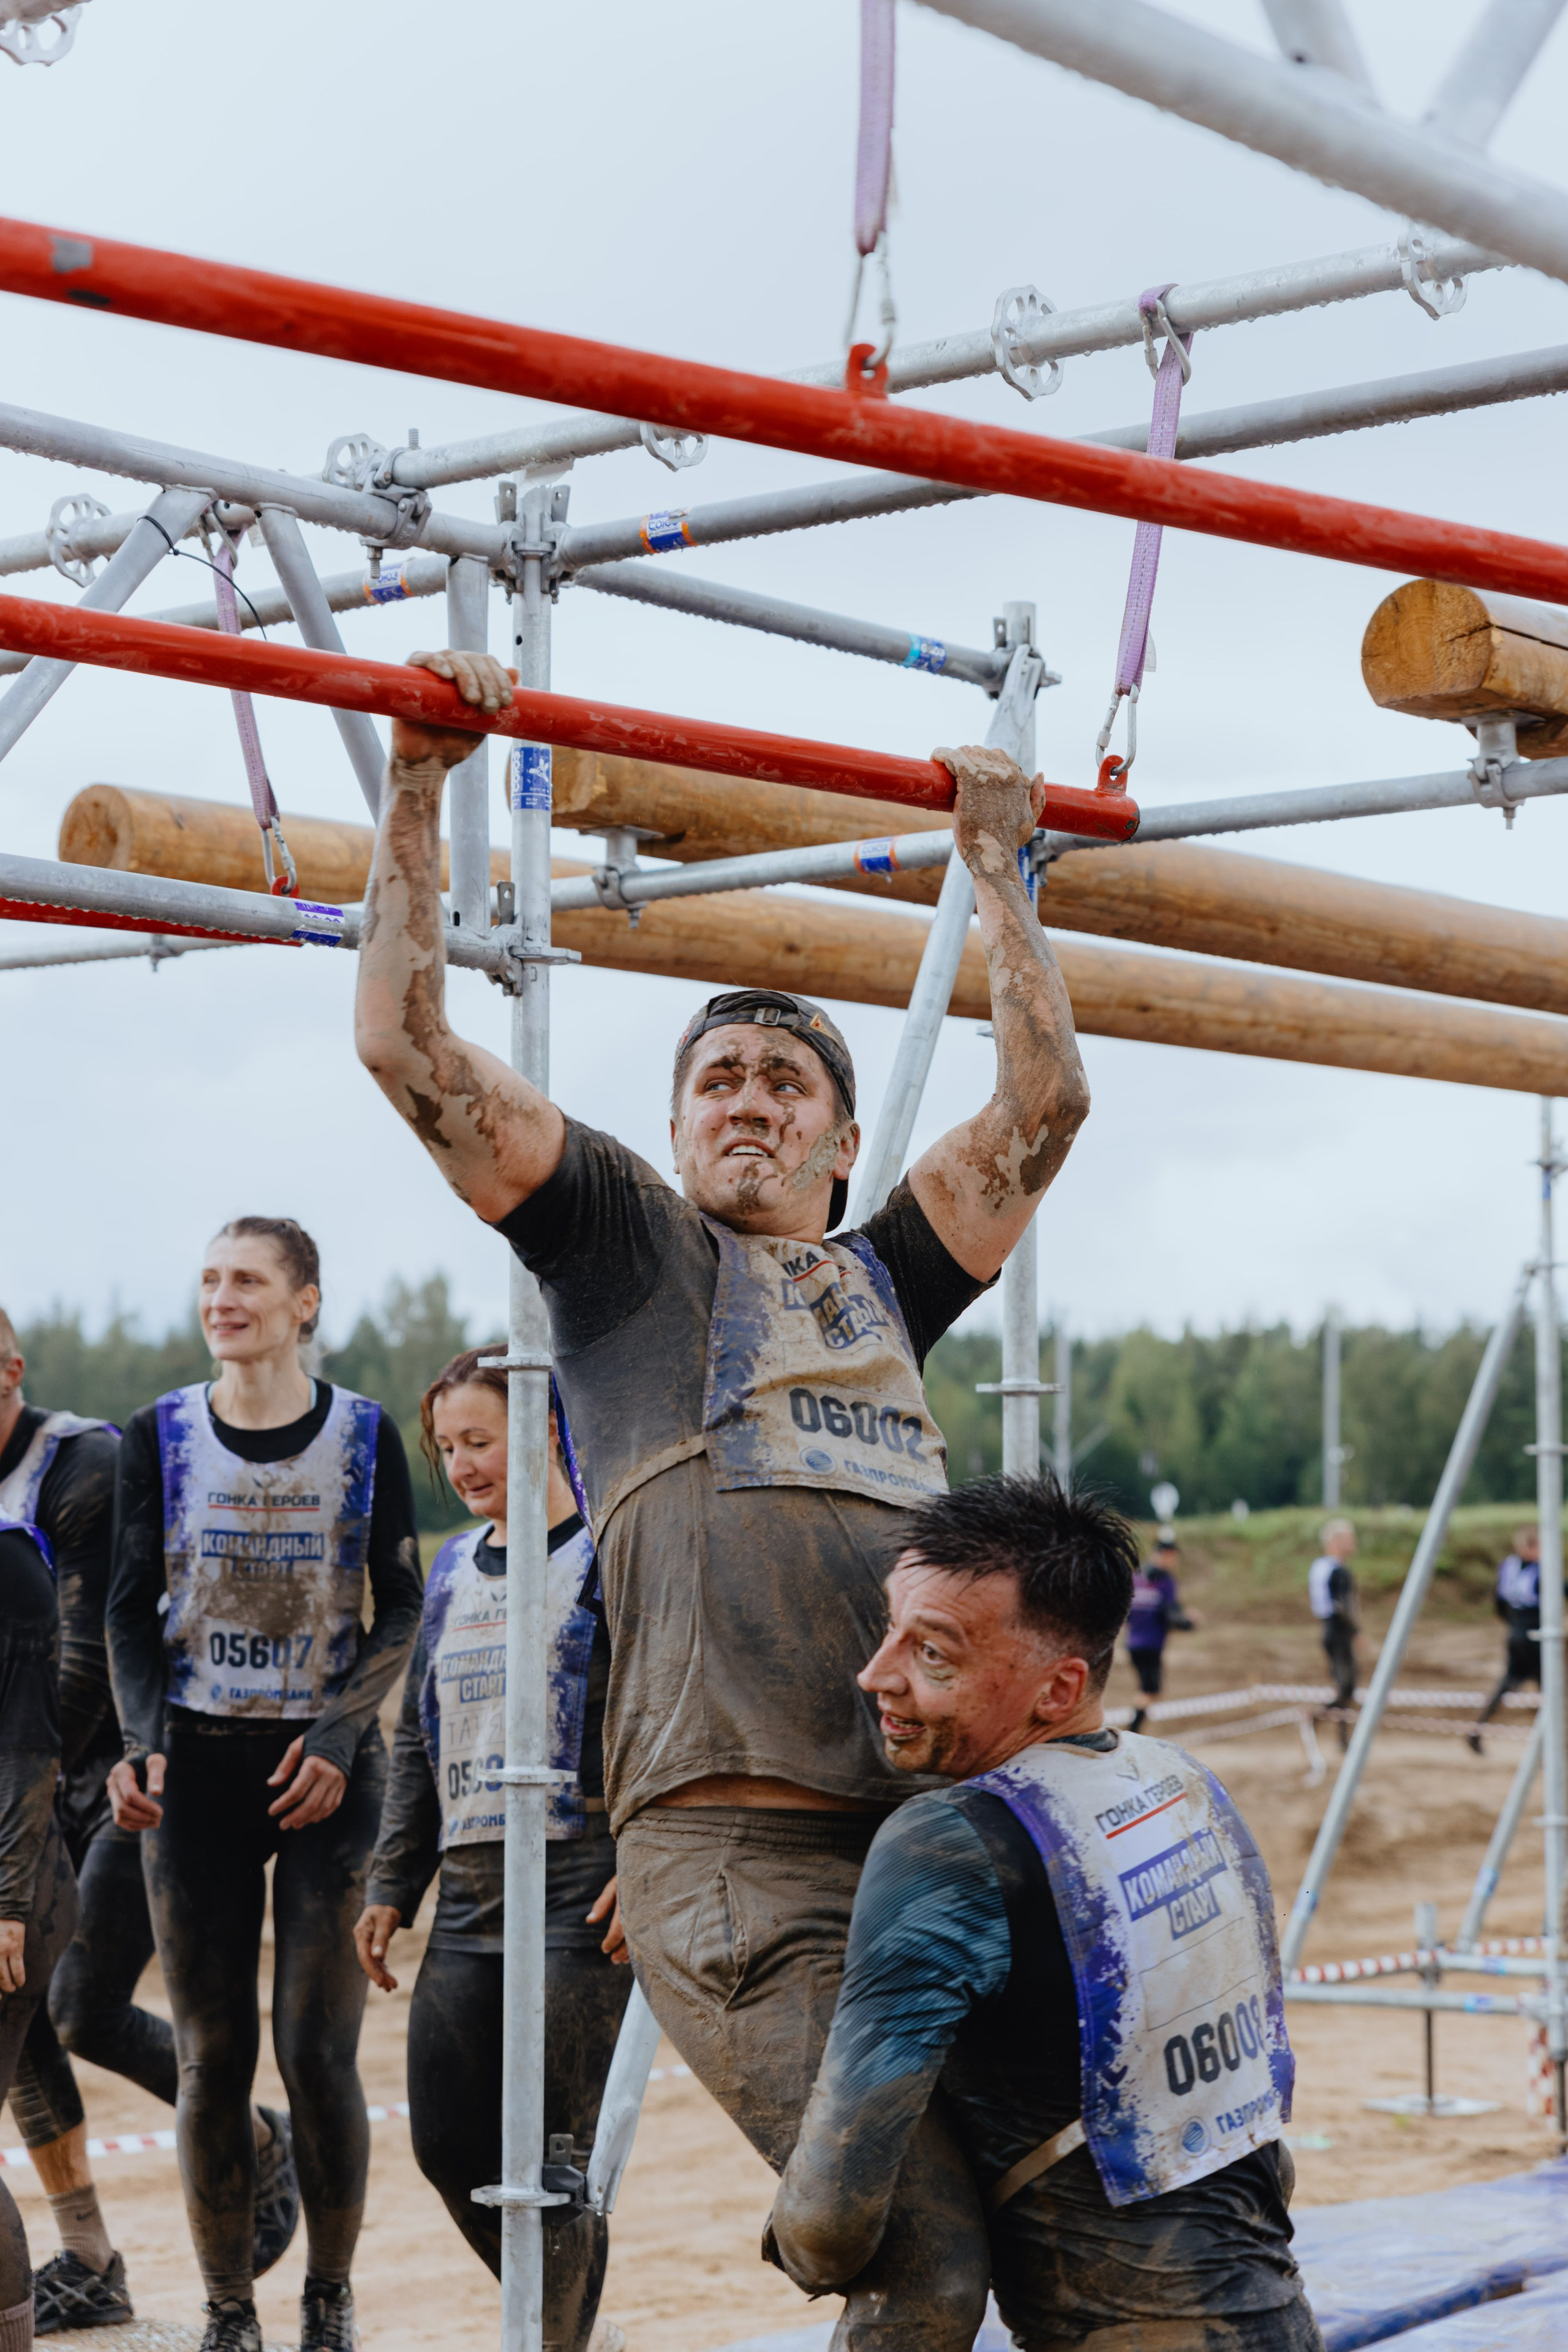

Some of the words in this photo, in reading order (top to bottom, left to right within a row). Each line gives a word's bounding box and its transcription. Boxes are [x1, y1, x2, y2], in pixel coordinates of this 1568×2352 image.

[790, 1387, 927, 1465] 06002
[208, 1491, 257, 1506] ГОНКА
[1095, 1795, 1147, 1833] ГОНКА
